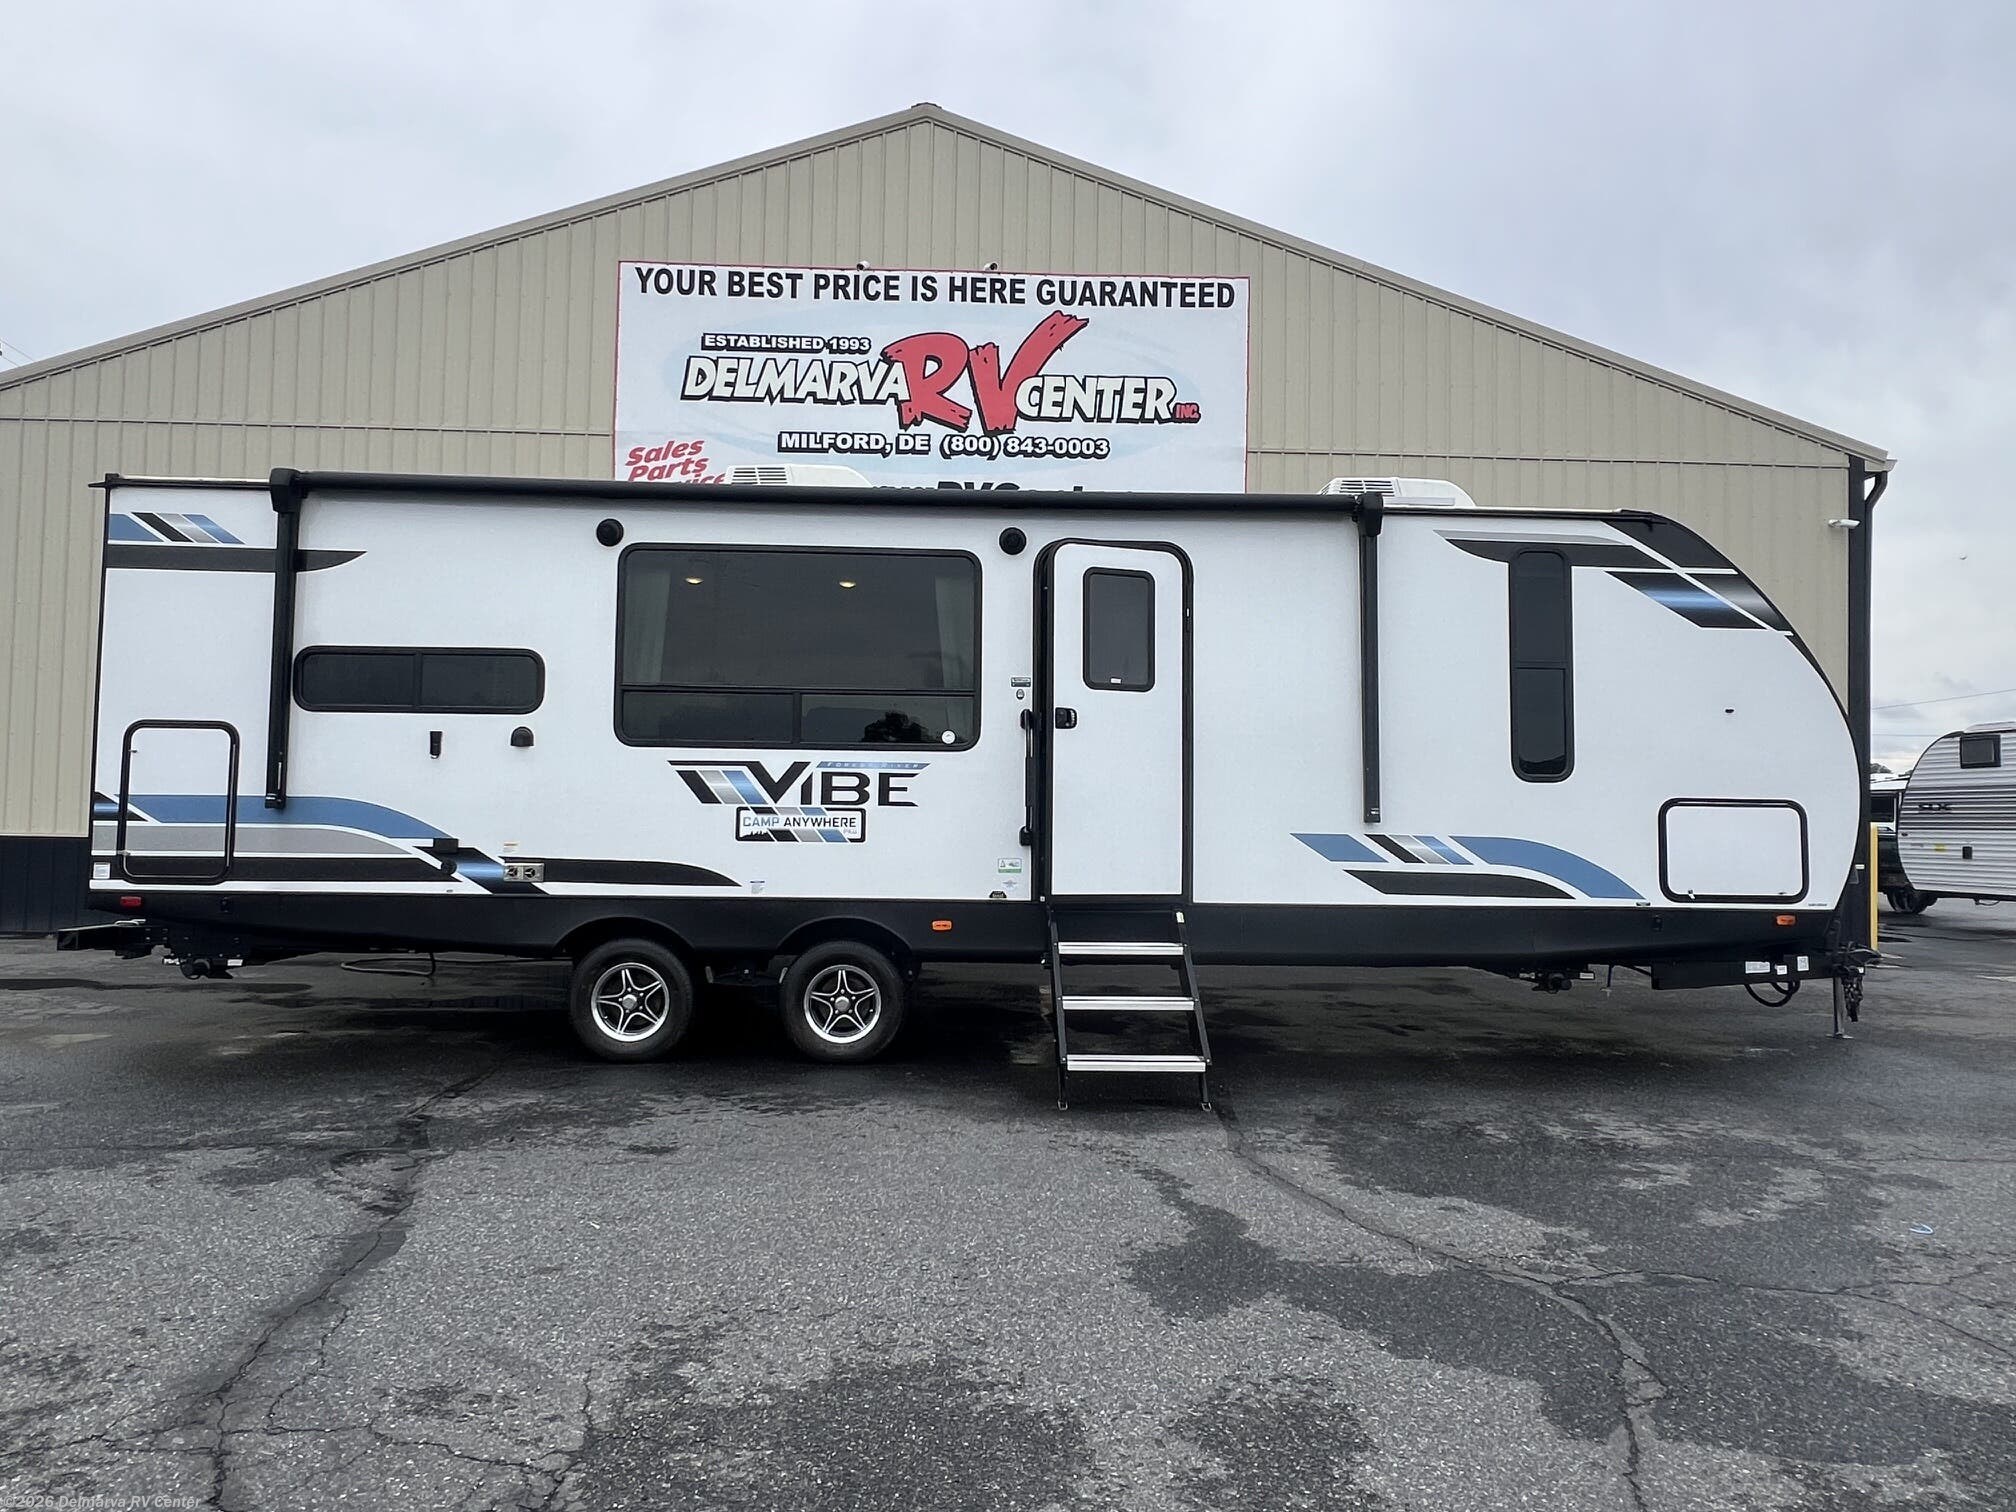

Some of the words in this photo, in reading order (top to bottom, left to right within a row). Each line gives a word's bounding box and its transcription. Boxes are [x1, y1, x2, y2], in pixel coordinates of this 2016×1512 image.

[635, 267, 717, 296] YOUR
[728, 271, 803, 299] BEST
[814, 274, 900, 300] PRICE
[911, 276, 938, 302] IS
[949, 277, 1026, 304] HERE
[1037, 280, 1235, 308] GUARANTEED
[703, 333, 825, 351] ESTABLISHED
[828, 337, 872, 353] 1993
[680, 356, 911, 404] DELMARVA
[881, 310, 1089, 434] RV
[1015, 375, 1177, 424] CENTER
[625, 440, 704, 466] Sales
[778, 431, 892, 457] MILFORD,
[895, 434, 931, 455] DE
[941, 435, 1000, 460] (800)
[1004, 436, 1110, 459] 843-0003
[628, 458, 709, 483] Parts
[744, 761, 920, 806] VIBE
[743, 816, 780, 827] CAMP
[783, 817, 857, 828] ANYWHERE
